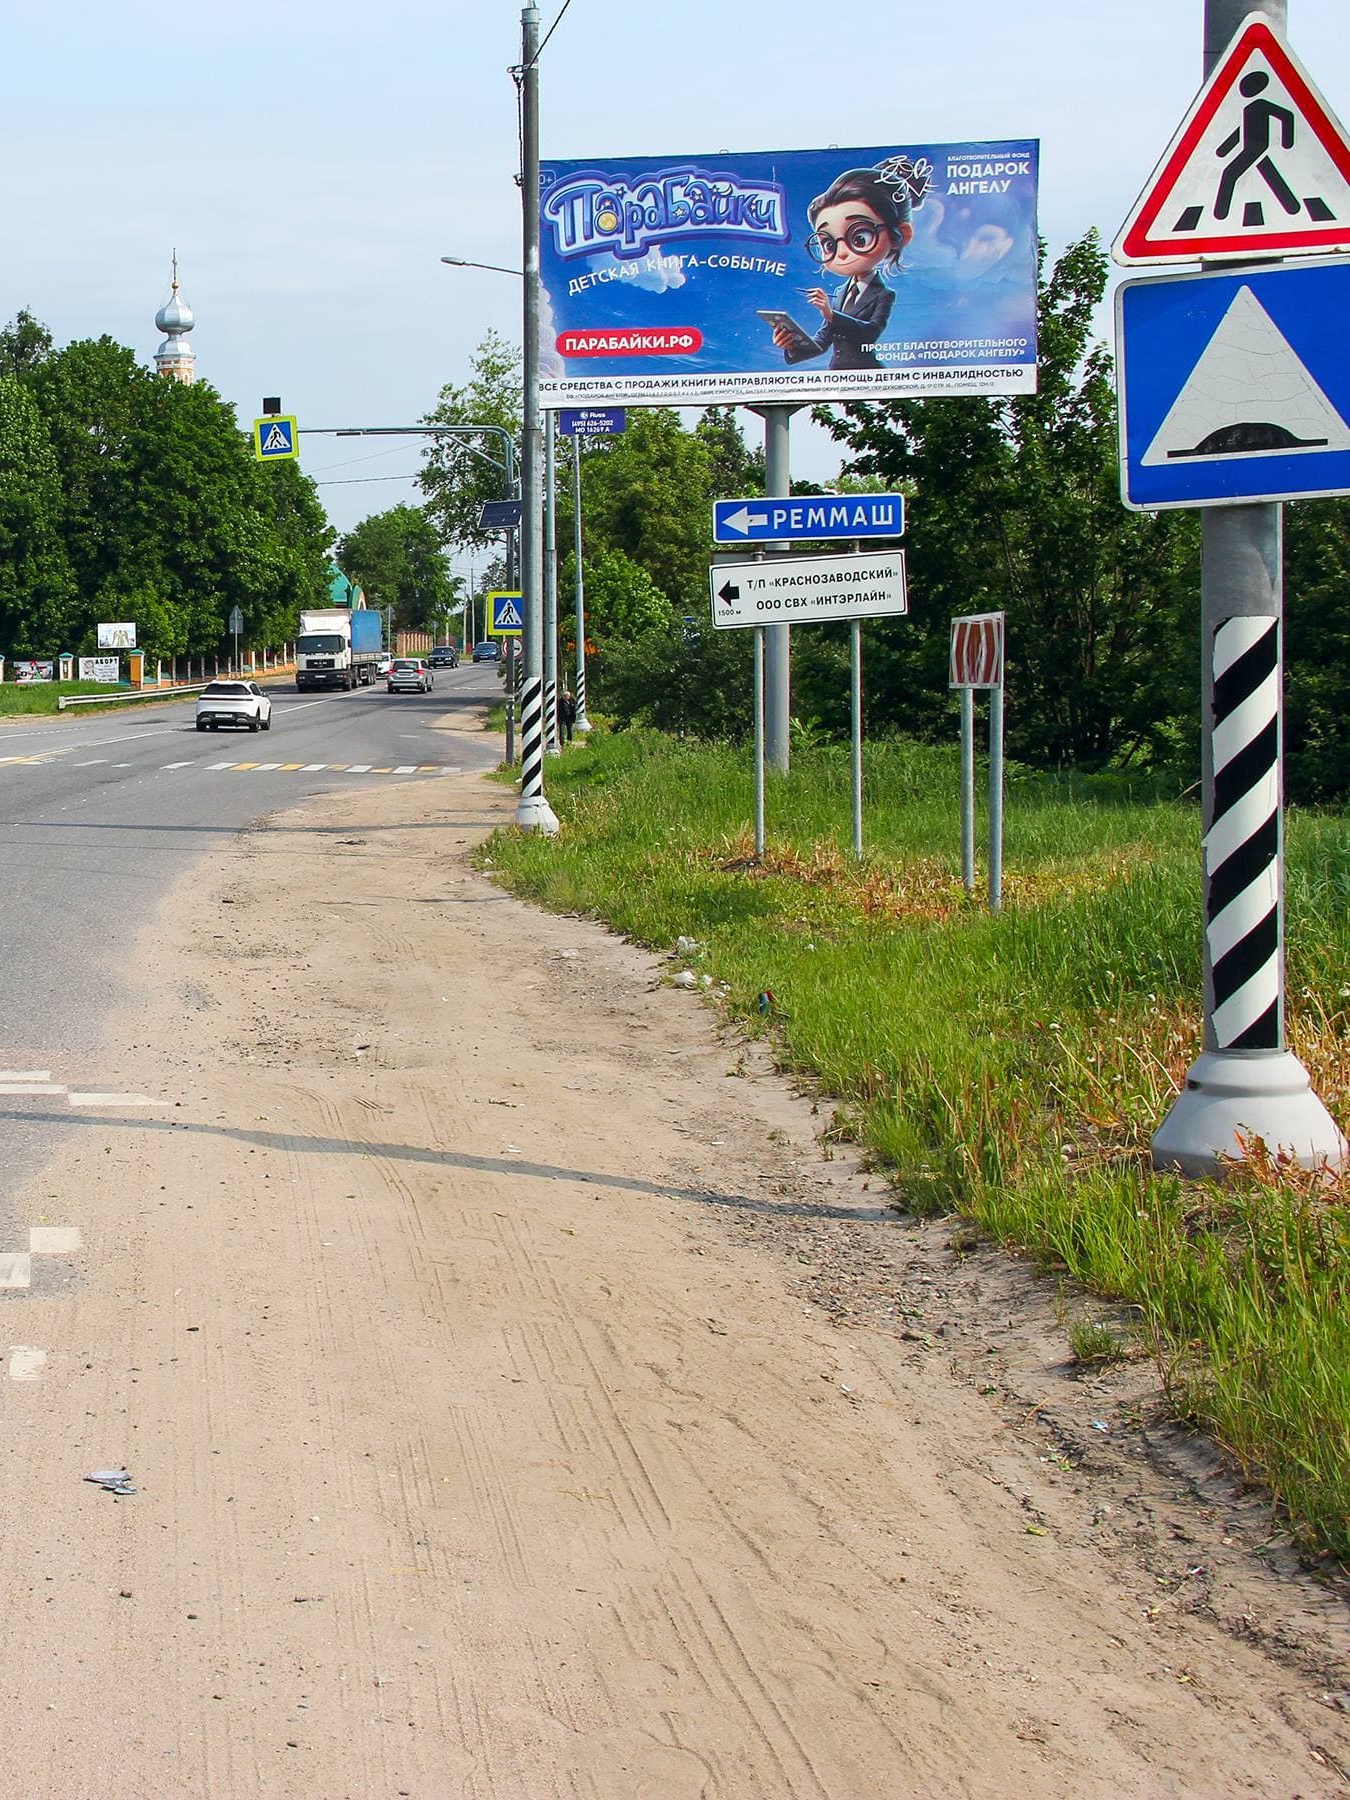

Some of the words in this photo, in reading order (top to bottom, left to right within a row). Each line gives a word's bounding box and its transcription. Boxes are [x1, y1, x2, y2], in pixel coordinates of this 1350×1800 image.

[946, 161, 1030, 178] ПОДАРОК
[946, 180, 1011, 195] АНГЕЛУ
[568, 262, 639, 296] ДЕТСКАЯ
[647, 254, 787, 277] КНИГА-СОБЫТИЕ
[565, 333, 693, 350] ПАРАБАЙКИ.РФ
[861, 342, 901, 352] ПРОЕКТ
[903, 338, 1027, 350] БЛАГОТВОРИТЕЛЬНОГО
[875, 352, 916, 362] ФОНДА
[917, 350, 974, 361] «ПОДАРОК
[975, 348, 1025, 358] АНГЕЛУ»
[538, 383, 558, 392] ВСЕ
[559, 380, 612, 391] СРЕДСТВА
[614, 380, 623, 389] С
[625, 379, 679, 390] ПРОДАЖИ
[681, 378, 717, 388] КНИГИ
[718, 375, 804, 387] НАПРАВЛЯЮТСЯ
[806, 374, 822, 384] НА
[824, 373, 874, 384] ПОМОЩЬ
[875, 371, 910, 382] ДЕТЯМ
[912, 371, 921, 381] С
[922, 368, 1024, 380] ИНВАЛИДНОСТЬЮ
[773, 504, 893, 530] РЕММАШ
[747, 579, 766, 591] Т/П
[769, 568, 899, 587] «КРАСНОЗАВОДСКИЙ»
[756, 600, 781, 611] ООО
[784, 598, 808, 609] СВХ
[810, 589, 892, 606] «ИНТЭРЛАЙН»
[717, 608, 735, 616] 1500
